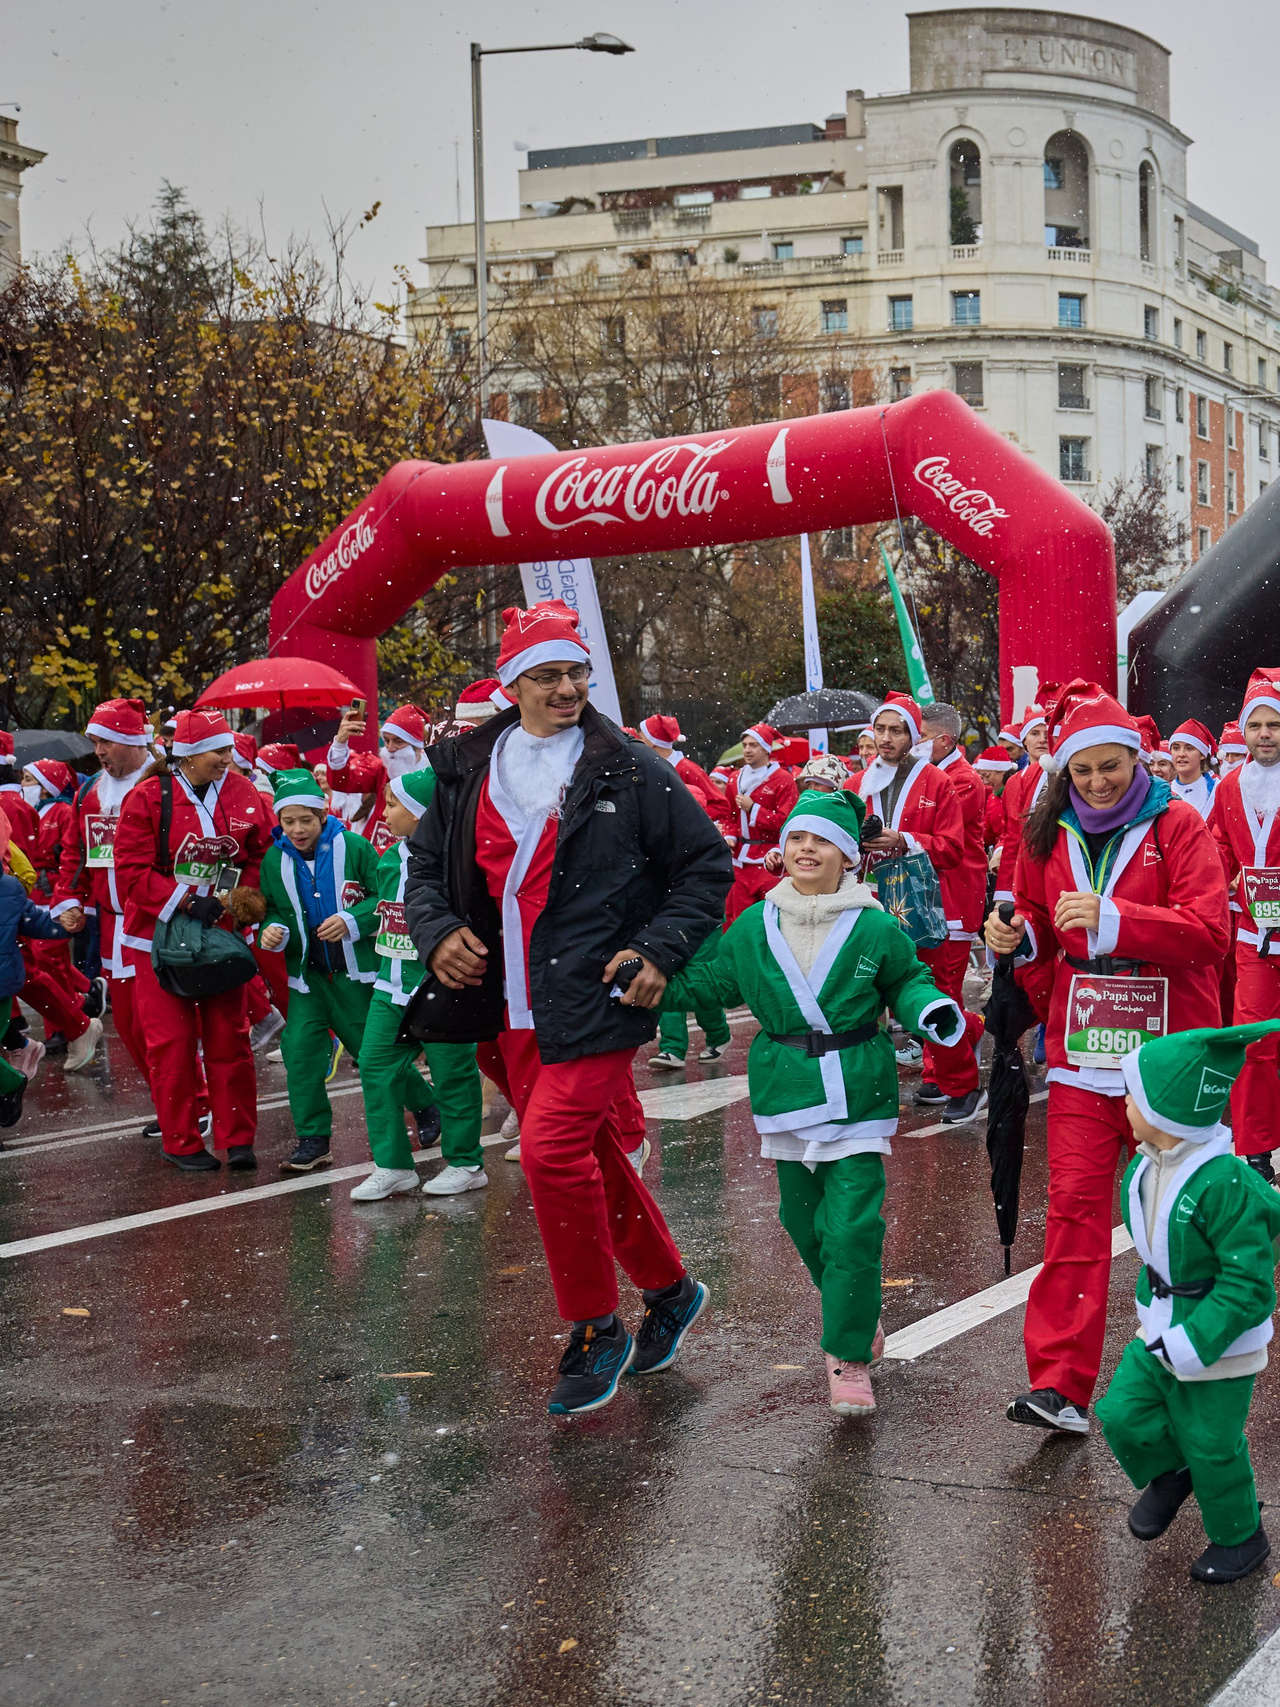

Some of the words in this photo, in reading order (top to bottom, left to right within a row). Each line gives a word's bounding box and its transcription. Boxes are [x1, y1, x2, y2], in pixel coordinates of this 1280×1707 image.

[1004, 38, 1125, 75] L'UNION
[535, 436, 741, 531] Coca-Cola
[914, 456, 1011, 537] Coca-Cola
[305, 510, 376, 600] Coca-Cola
[1102, 990, 1129, 1003] Papá
[1131, 992, 1157, 1002] Noel
[1087, 1028, 1141, 1053] 8960
[1203, 1084, 1211, 1094] El
[1211, 1085, 1226, 1094] Corte
